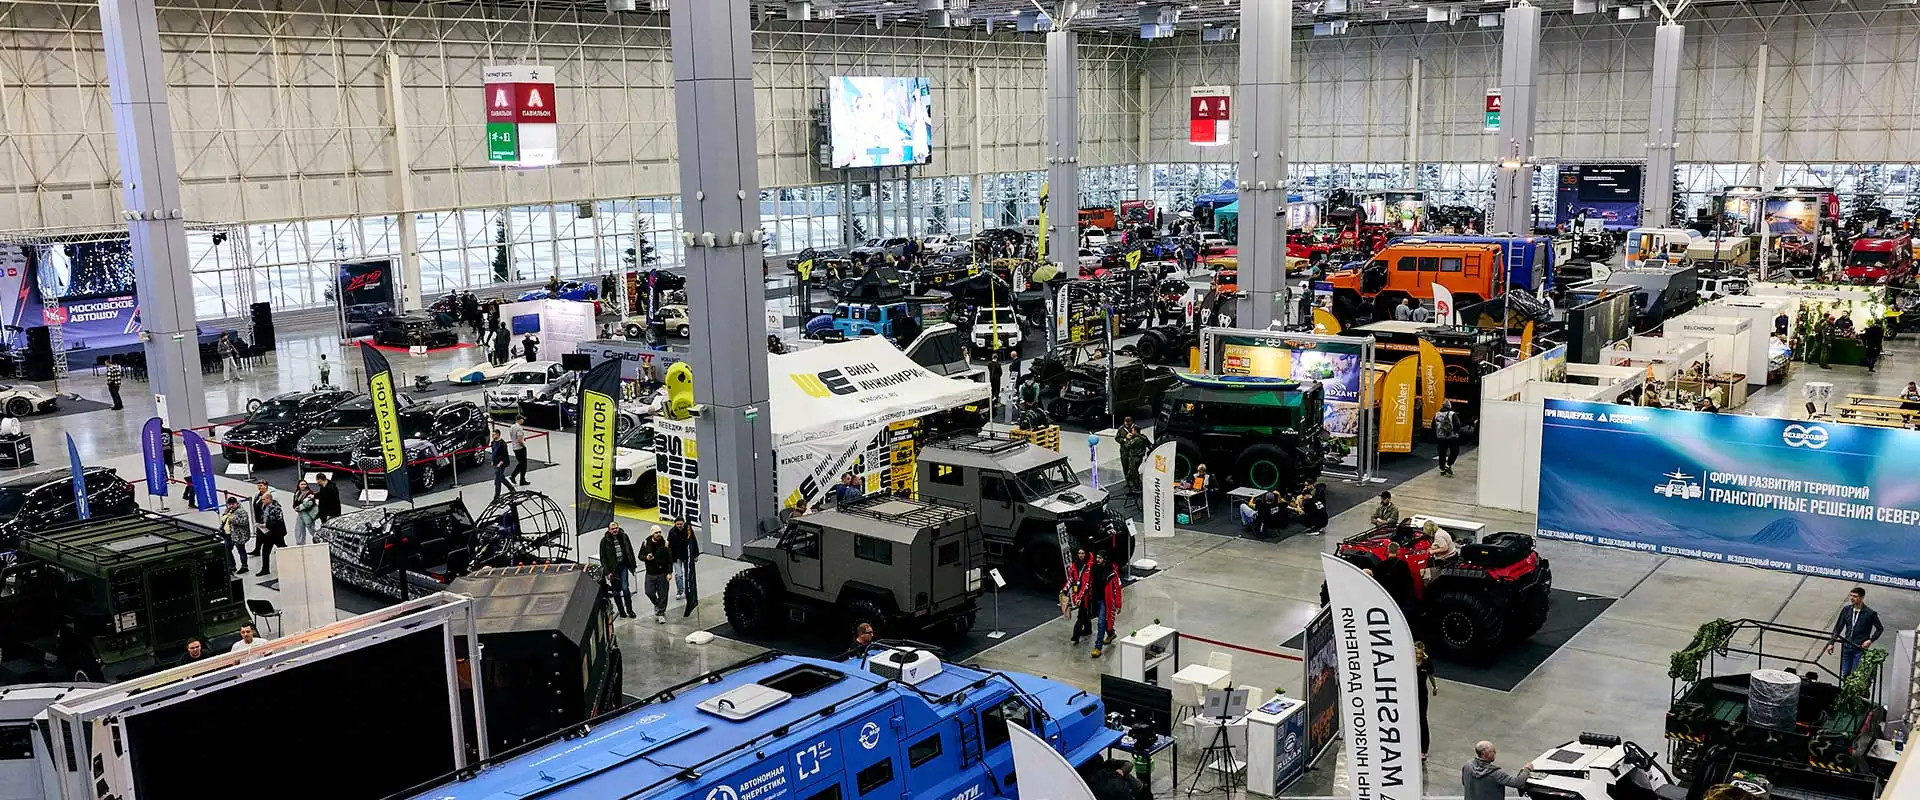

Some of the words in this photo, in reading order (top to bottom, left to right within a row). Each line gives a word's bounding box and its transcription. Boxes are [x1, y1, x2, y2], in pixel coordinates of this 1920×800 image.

[69, 299, 134, 314] МОСКОВСКОЕ
[70, 310, 119, 323] АВТОШОУ
[844, 362, 880, 378] ВИНЧ
[1324, 390, 1358, 398] АРХАНТ
[1396, 383, 1408, 425] LizaAlert
[1544, 409, 1557, 417] ПРИ
[1557, 410, 1594, 421] ПОДДЕРЖКЕ
[592, 401, 606, 491] ALLIGATOR
[780, 452, 813, 465] WINCHES.RU
[814, 453, 834, 476] ВИНЧ
[820, 440, 859, 487] ИНЖИНИРИНГ
[1709, 471, 1747, 487] ФОРУМ
[1749, 475, 1801, 492] РАЗВИТИЯ
[1803, 480, 1870, 500] ТЕРРИТОРИЙ
[1709, 487, 1807, 513] ТРАНСПОРТНЫЕ
[1810, 500, 1874, 521] РЕШЕНИЯ
[1876, 507, 1920, 526] СЕВЕР
[1537, 528, 1574, 540] ВЕЗДЕХОДНЫЙ
[1575, 533, 1594, 543] ФОРУМ
[1598, 536, 1636, 549] ВЕЗДЕХОДНЫЙ
[1637, 542, 1656, 551] ФОРУМ
[1661, 545, 1701, 557] ВЕЗДЕХОДНЫЙ
[1702, 551, 1722, 560] ФОРУМ
[1727, 554, 1769, 567] ВЕЗДЕХОДНЫЙ
[1770, 560, 1792, 570] ФОРУМ
[1796, 564, 1841, 577] ВЕЗДЕХОДНЫЙ
[1841, 570, 1864, 580] ФОРУМ
[1869, 573, 1917, 587] ВЕЗДЕХОДНЫЙ
[739, 765, 785, 793] АВТОНОМНАЯ
[741, 776, 786, 800] ЭНЕРГЕТИКА
